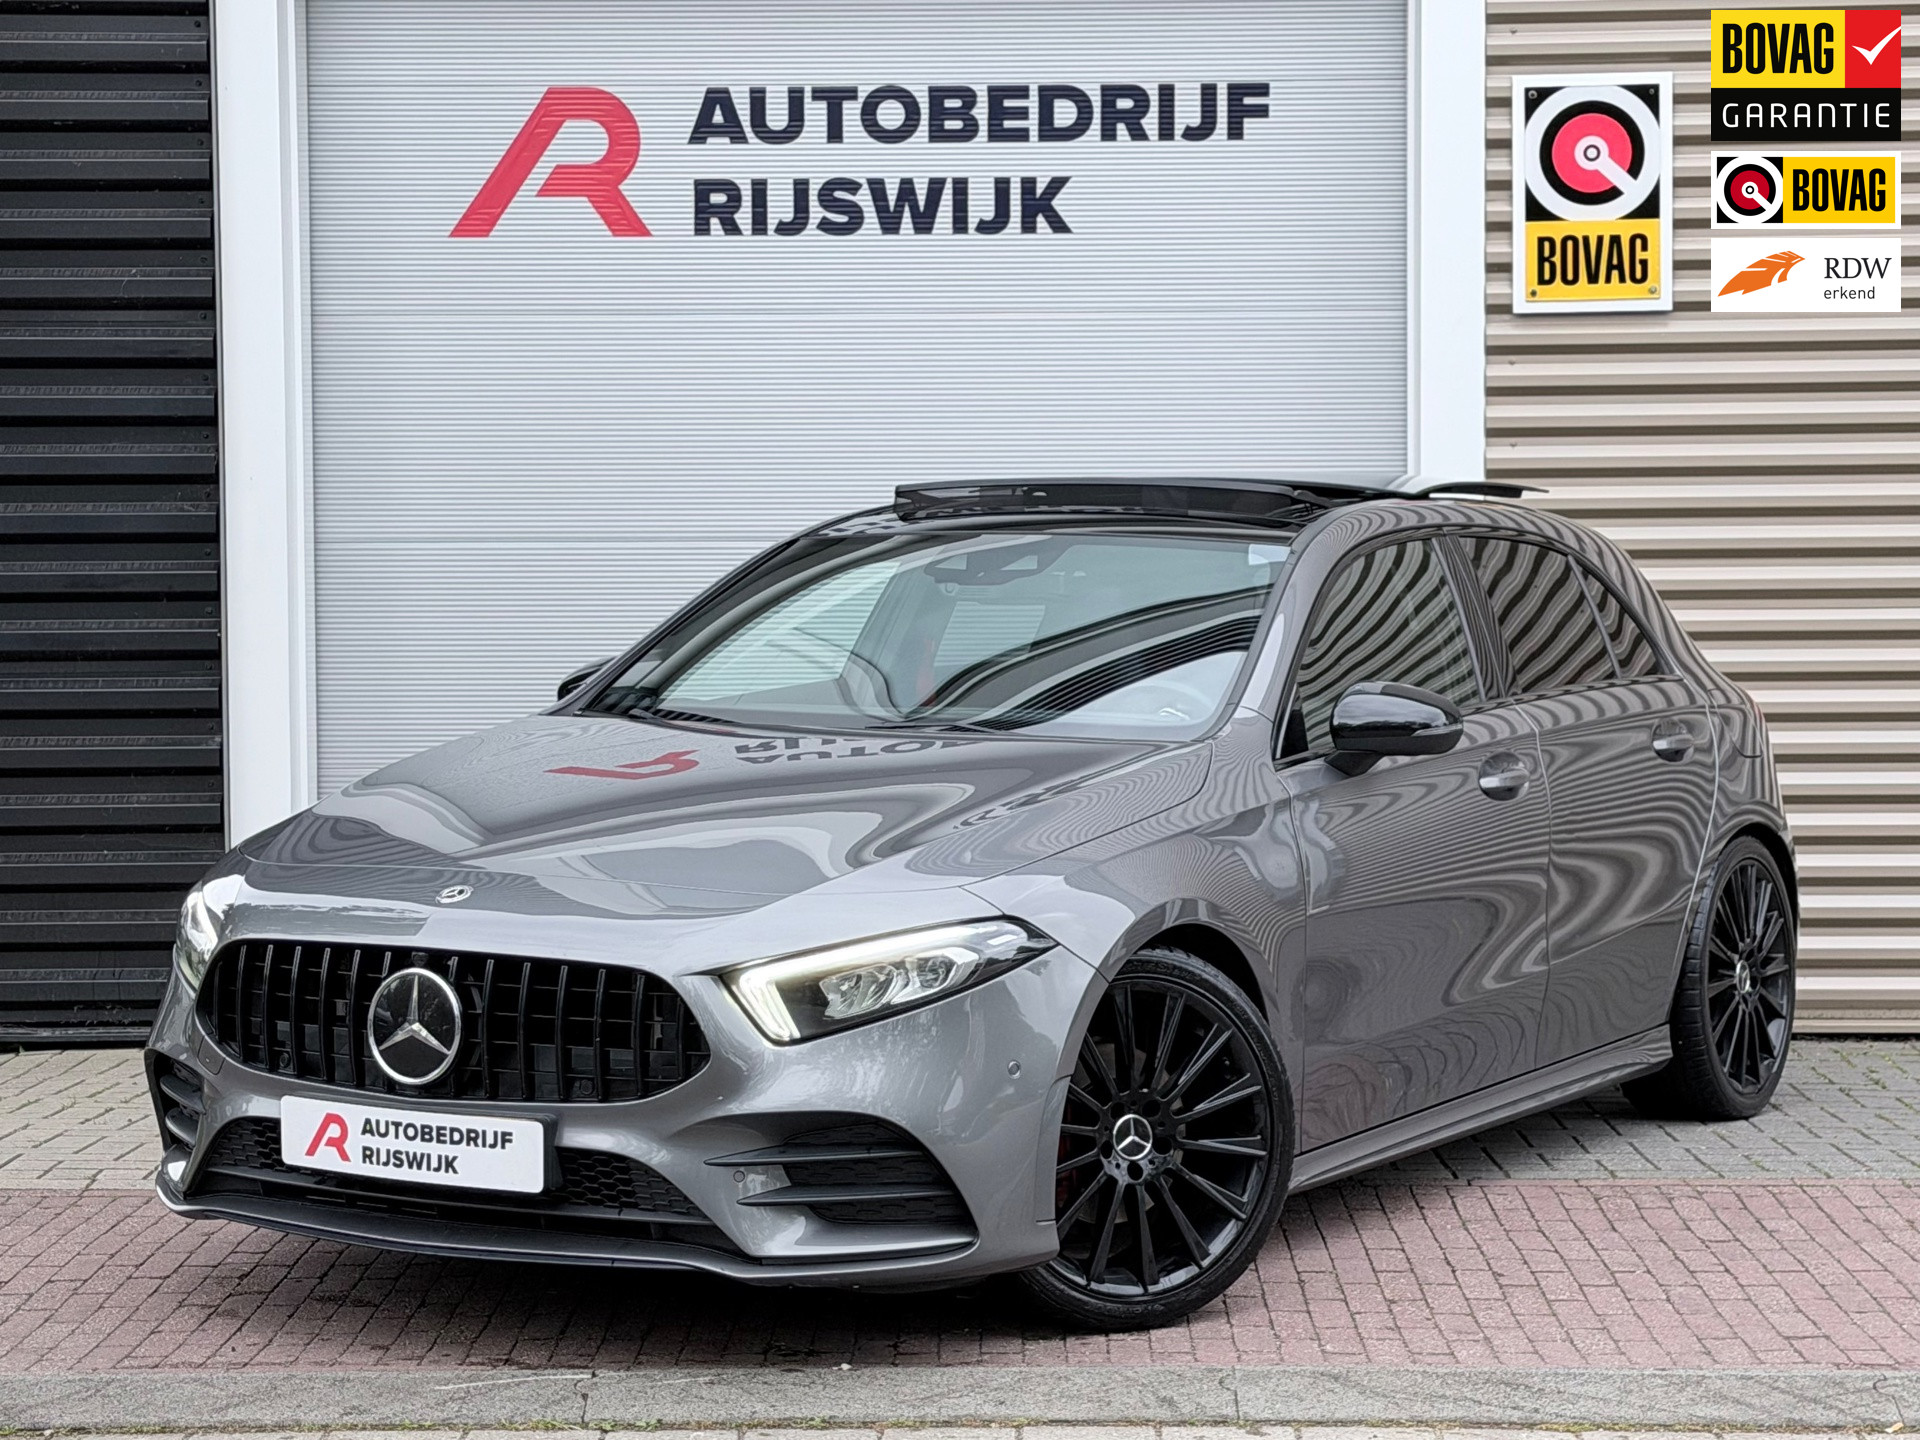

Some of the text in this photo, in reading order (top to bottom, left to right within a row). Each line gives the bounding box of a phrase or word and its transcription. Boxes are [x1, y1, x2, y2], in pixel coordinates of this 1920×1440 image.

[688, 83, 1270, 145] AUTOBEDRIJF
[694, 177, 1073, 236] RIJSWIJK
[1536, 233, 1649, 286] BOVAG
[360, 1118, 514, 1149] AUTOBEDRIJF
[361, 1146, 459, 1174] RIJSWIJK
